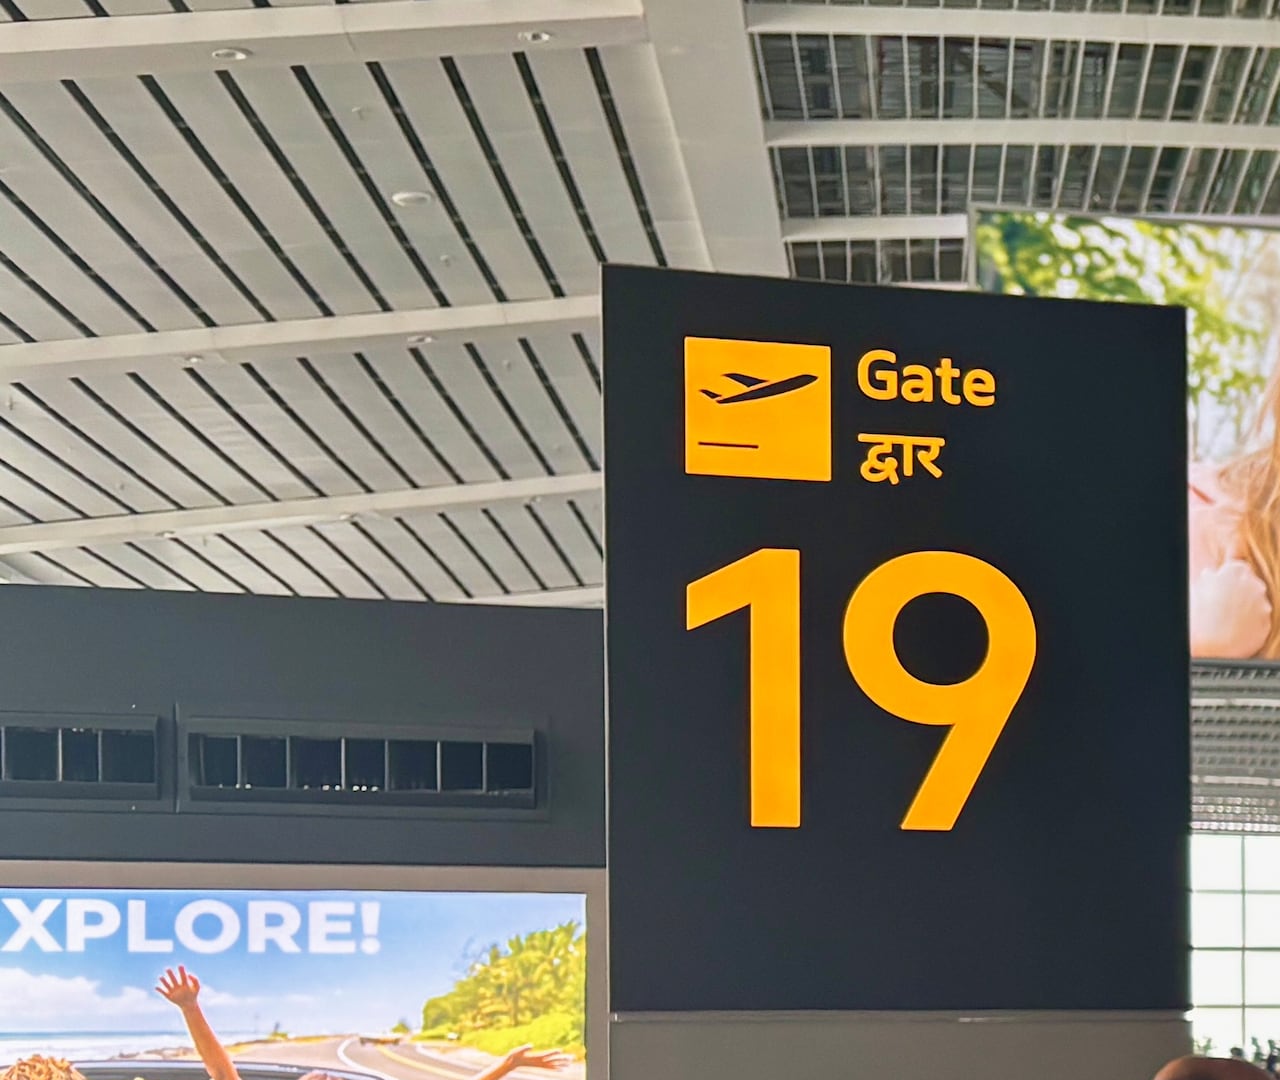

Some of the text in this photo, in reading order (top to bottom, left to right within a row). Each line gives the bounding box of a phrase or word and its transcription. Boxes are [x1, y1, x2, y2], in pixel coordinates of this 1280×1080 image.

[858, 350, 995, 406] Gate
[857, 433, 946, 485] द्वार
[685, 547, 1037, 830] 19
[1, 898, 380, 954] XPLORE!
